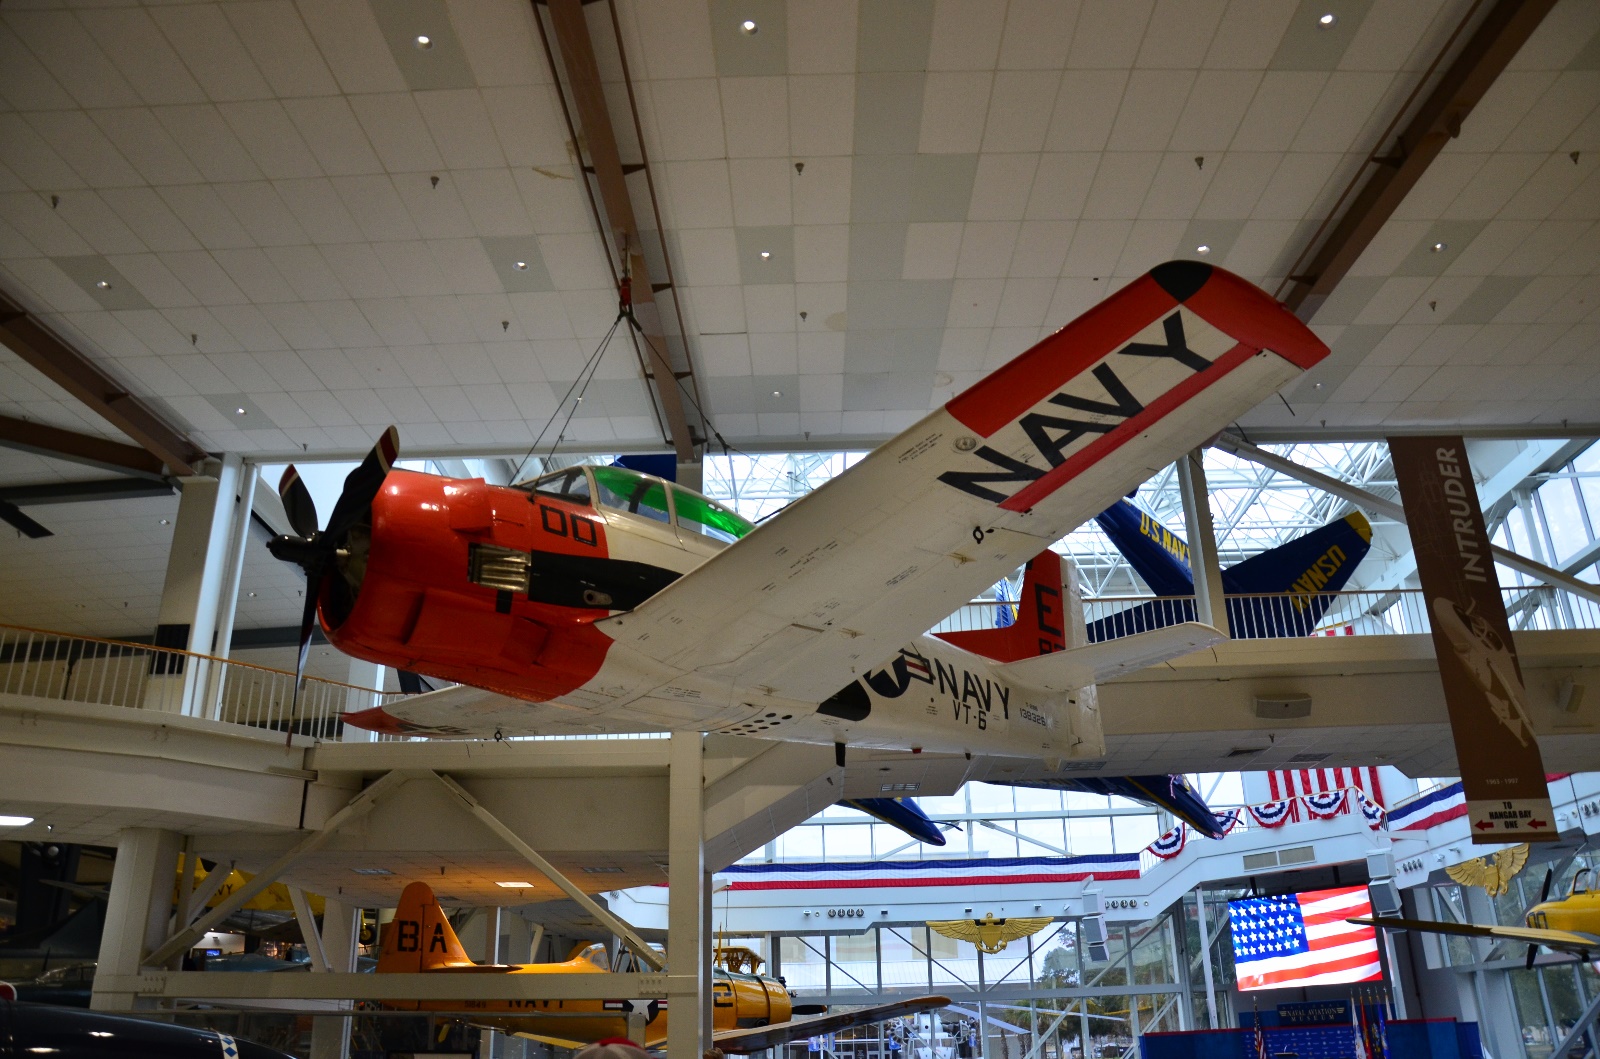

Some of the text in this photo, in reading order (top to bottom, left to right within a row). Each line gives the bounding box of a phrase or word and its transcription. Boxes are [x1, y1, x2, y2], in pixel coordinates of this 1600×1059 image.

[937, 310, 1214, 503] NAVY
[1436, 447, 1487, 583] INTRUDER
[1035, 583, 1062, 637] E
[934, 657, 1009, 720] NAVY
[1489, 810, 1532, 820] HANGAR BAY
[1503, 801, 1513, 810] TO
[1504, 820, 1519, 829] ONE
[1308, 1007, 1337, 1016] AVIATION
